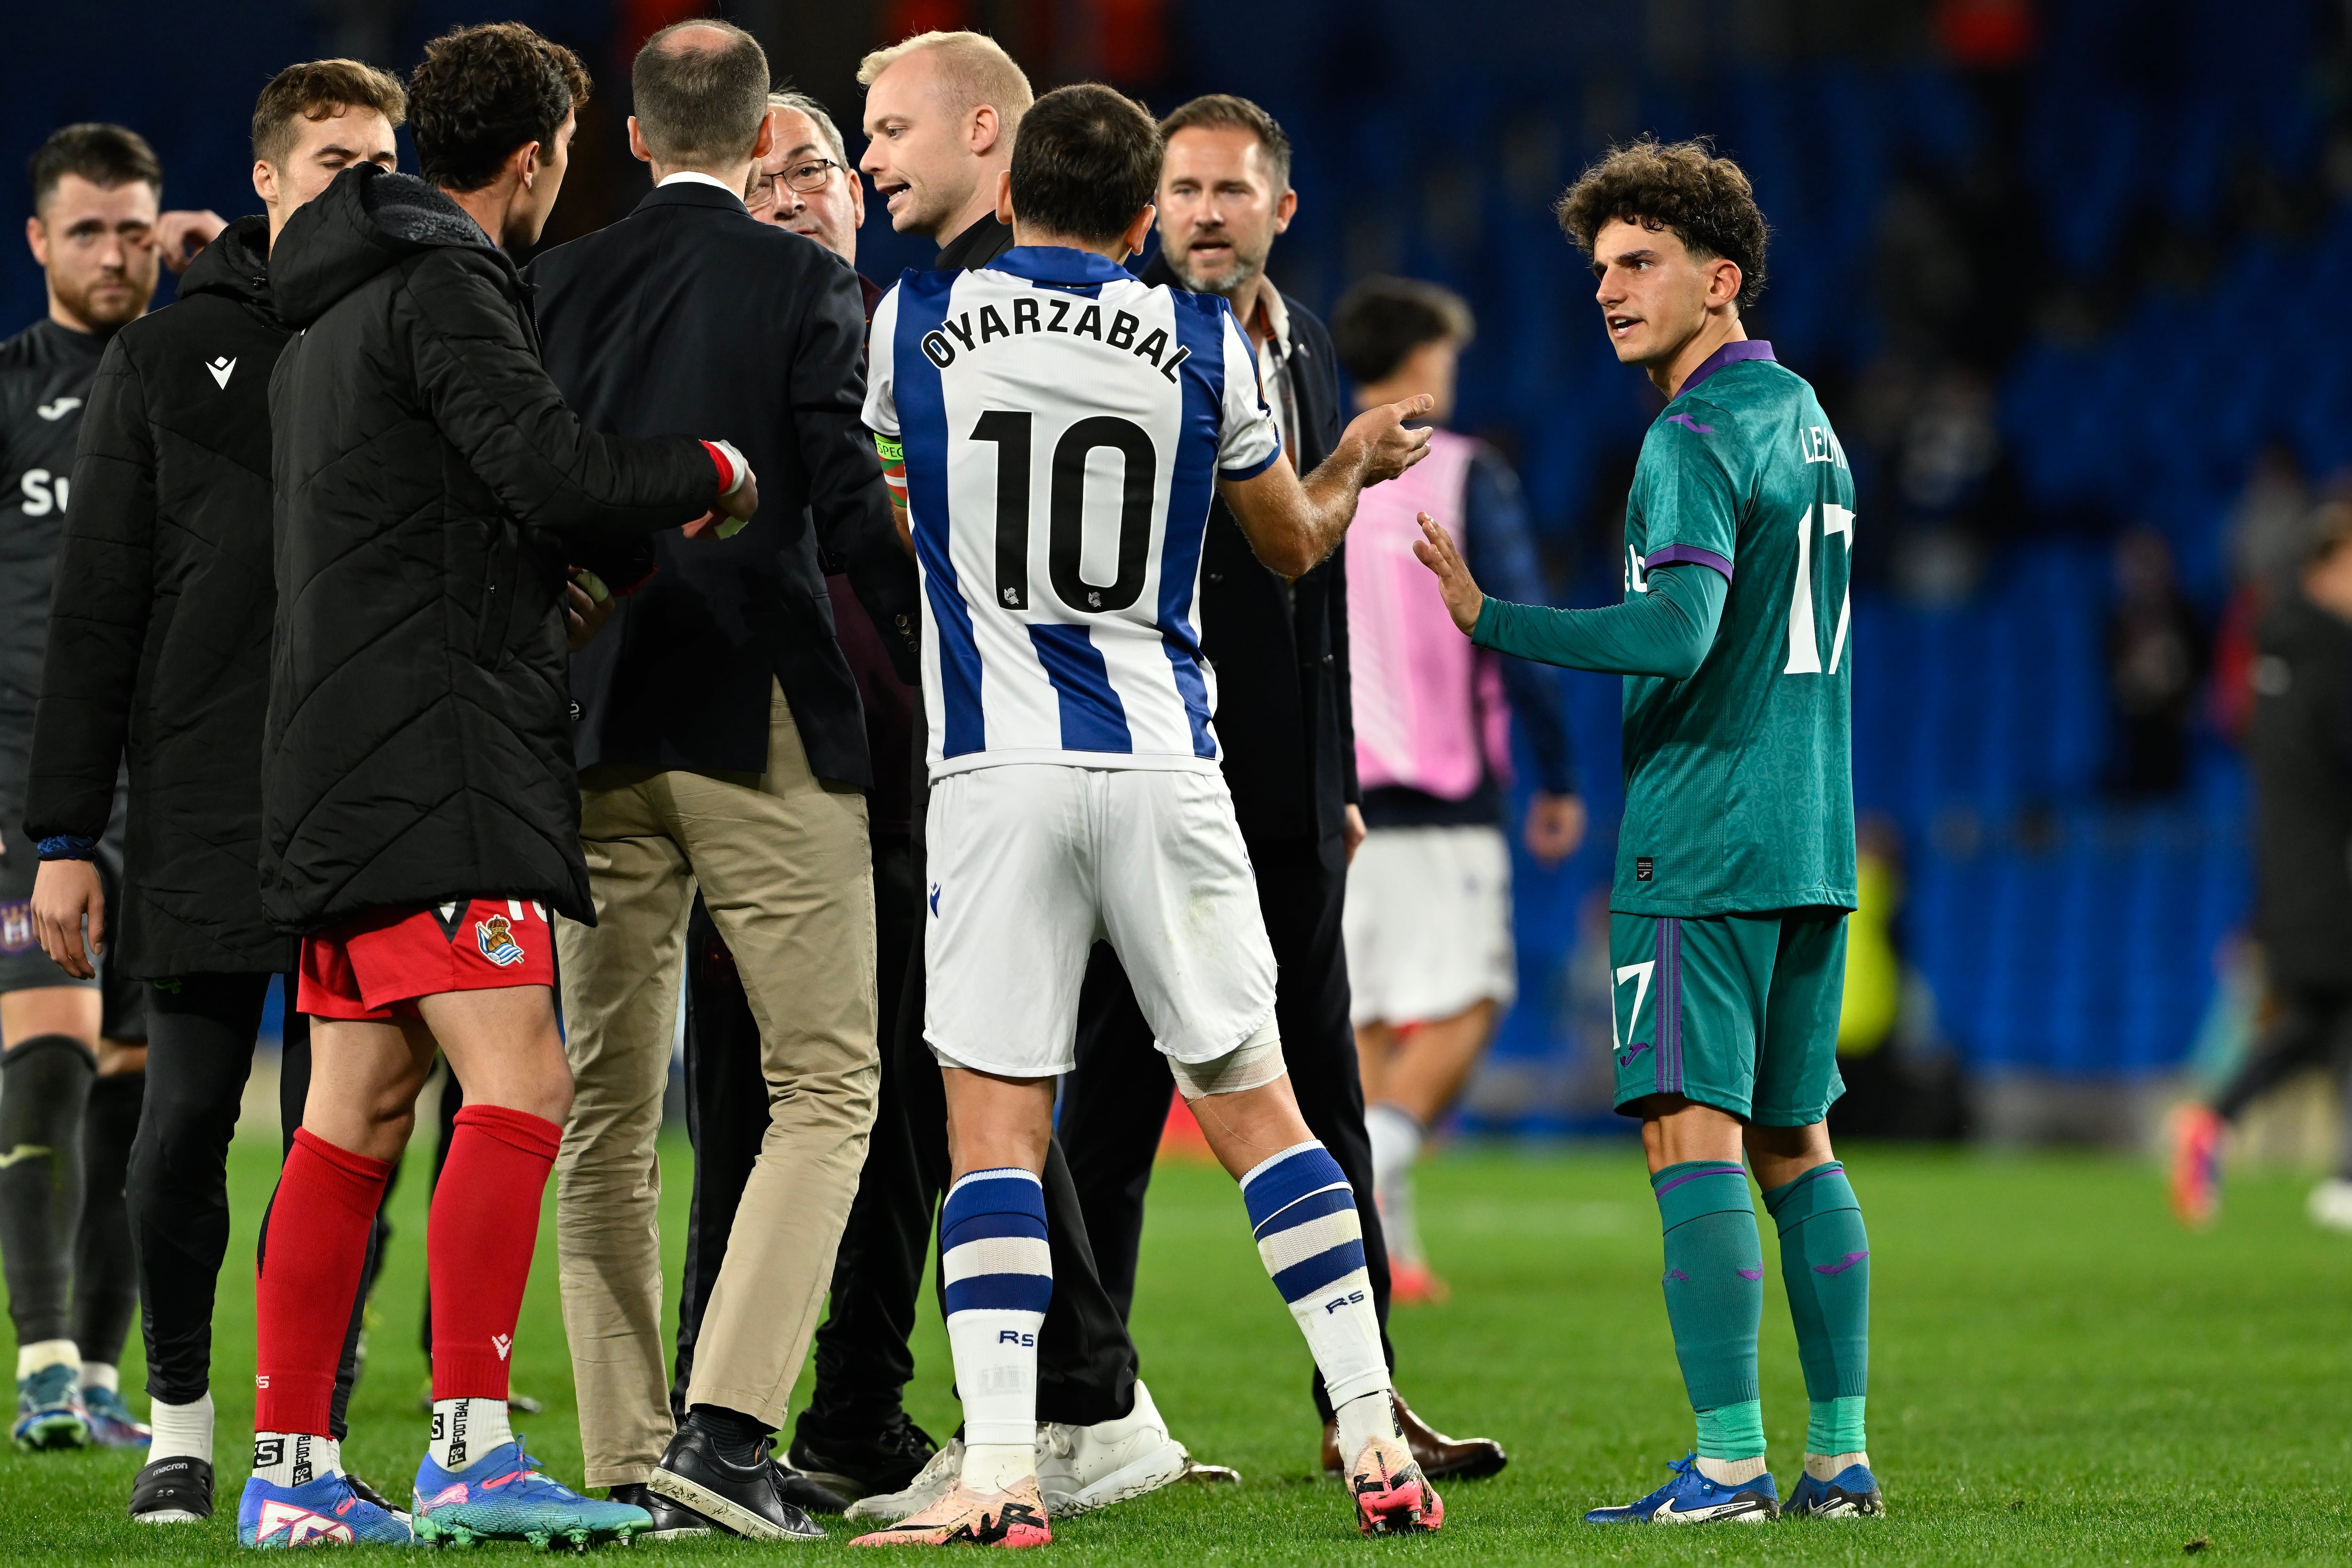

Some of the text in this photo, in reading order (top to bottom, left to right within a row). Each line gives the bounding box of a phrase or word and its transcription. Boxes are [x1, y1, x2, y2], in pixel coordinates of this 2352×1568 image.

[922, 298, 1192, 384] OYARZABAL
[969, 410, 1157, 613] 10
[1783, 503, 1856, 674] 17
[1325, 1290, 1364, 1315] RS
[999, 1330, 1033, 1347] RS
[453, 1398, 469, 1444] FOOTBAL
[296, 1433, 311, 1465] FOOTB
[153, 1463, 188, 1476] macron
